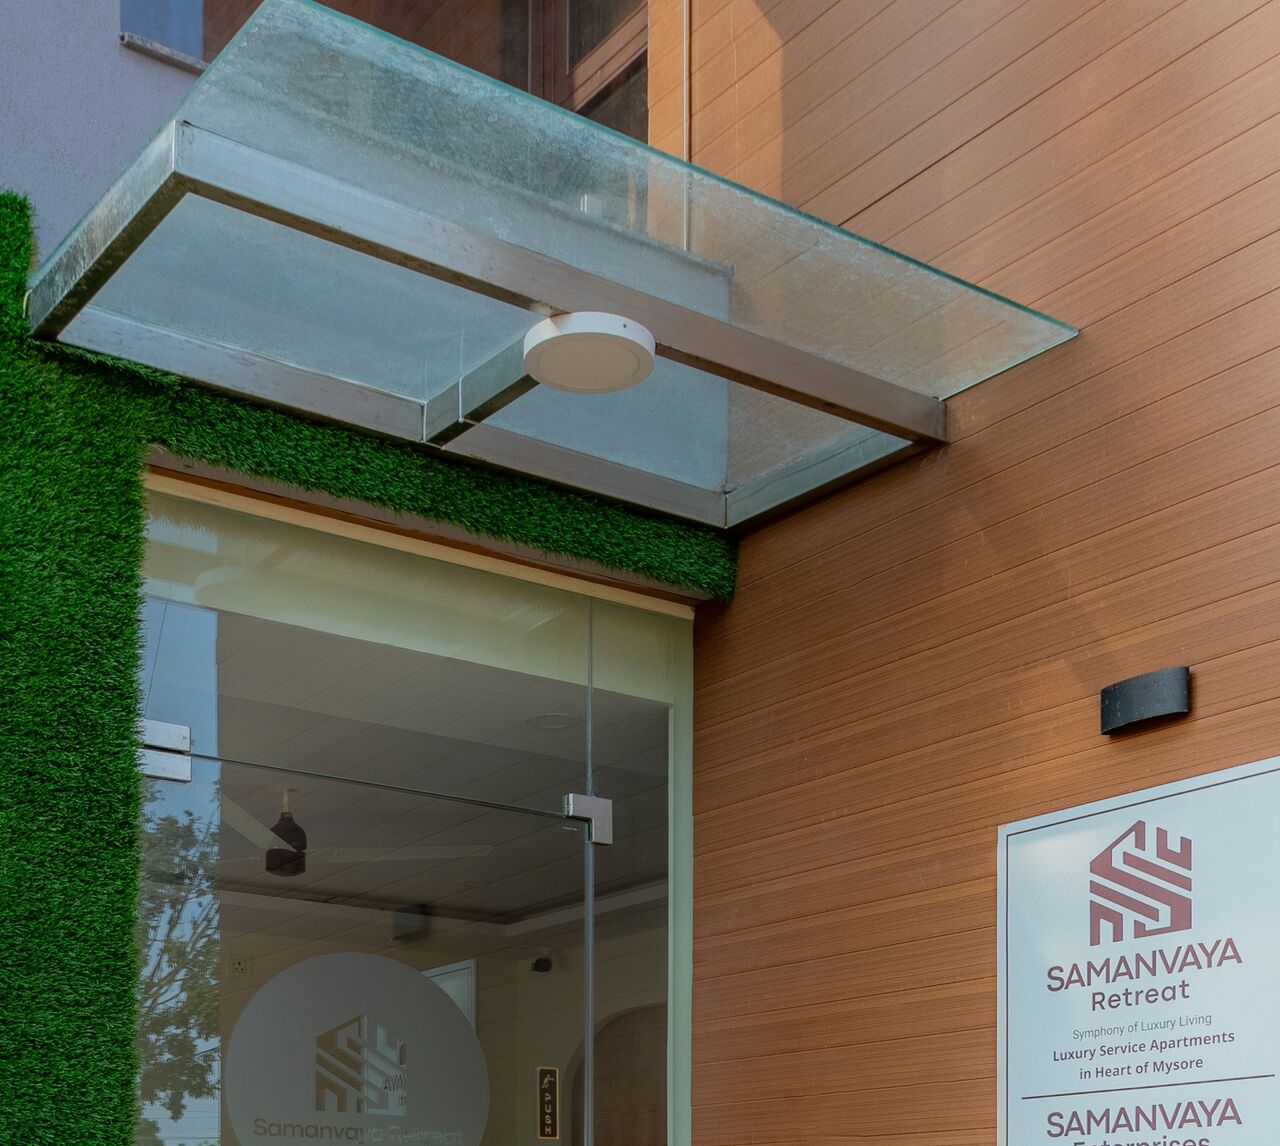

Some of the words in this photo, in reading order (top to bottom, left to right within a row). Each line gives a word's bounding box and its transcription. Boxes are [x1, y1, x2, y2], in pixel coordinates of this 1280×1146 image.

[1046, 937, 1243, 992] SAMANVAYA
[1091, 980, 1190, 1011] Retreat
[1072, 1025, 1125, 1041] Symphony
[1128, 1022, 1139, 1033] of
[1141, 1018, 1176, 1032] Luxury
[1179, 1014, 1212, 1028] Living
[1053, 1047, 1096, 1062] Luxury
[1099, 1041, 1146, 1056] Service
[1150, 1031, 1235, 1052] Apartments
[1080, 1068, 1091, 1080] in
[1095, 1063, 1132, 1078] Heart
[1135, 1061, 1149, 1074] of
[1153, 1057, 1203, 1075] Mysore
[544, 1093, 552, 1135] PUSH
[1046, 1098, 1243, 1138] SAMANVAYA
[253, 1118, 385, 1145] Samanvaya
